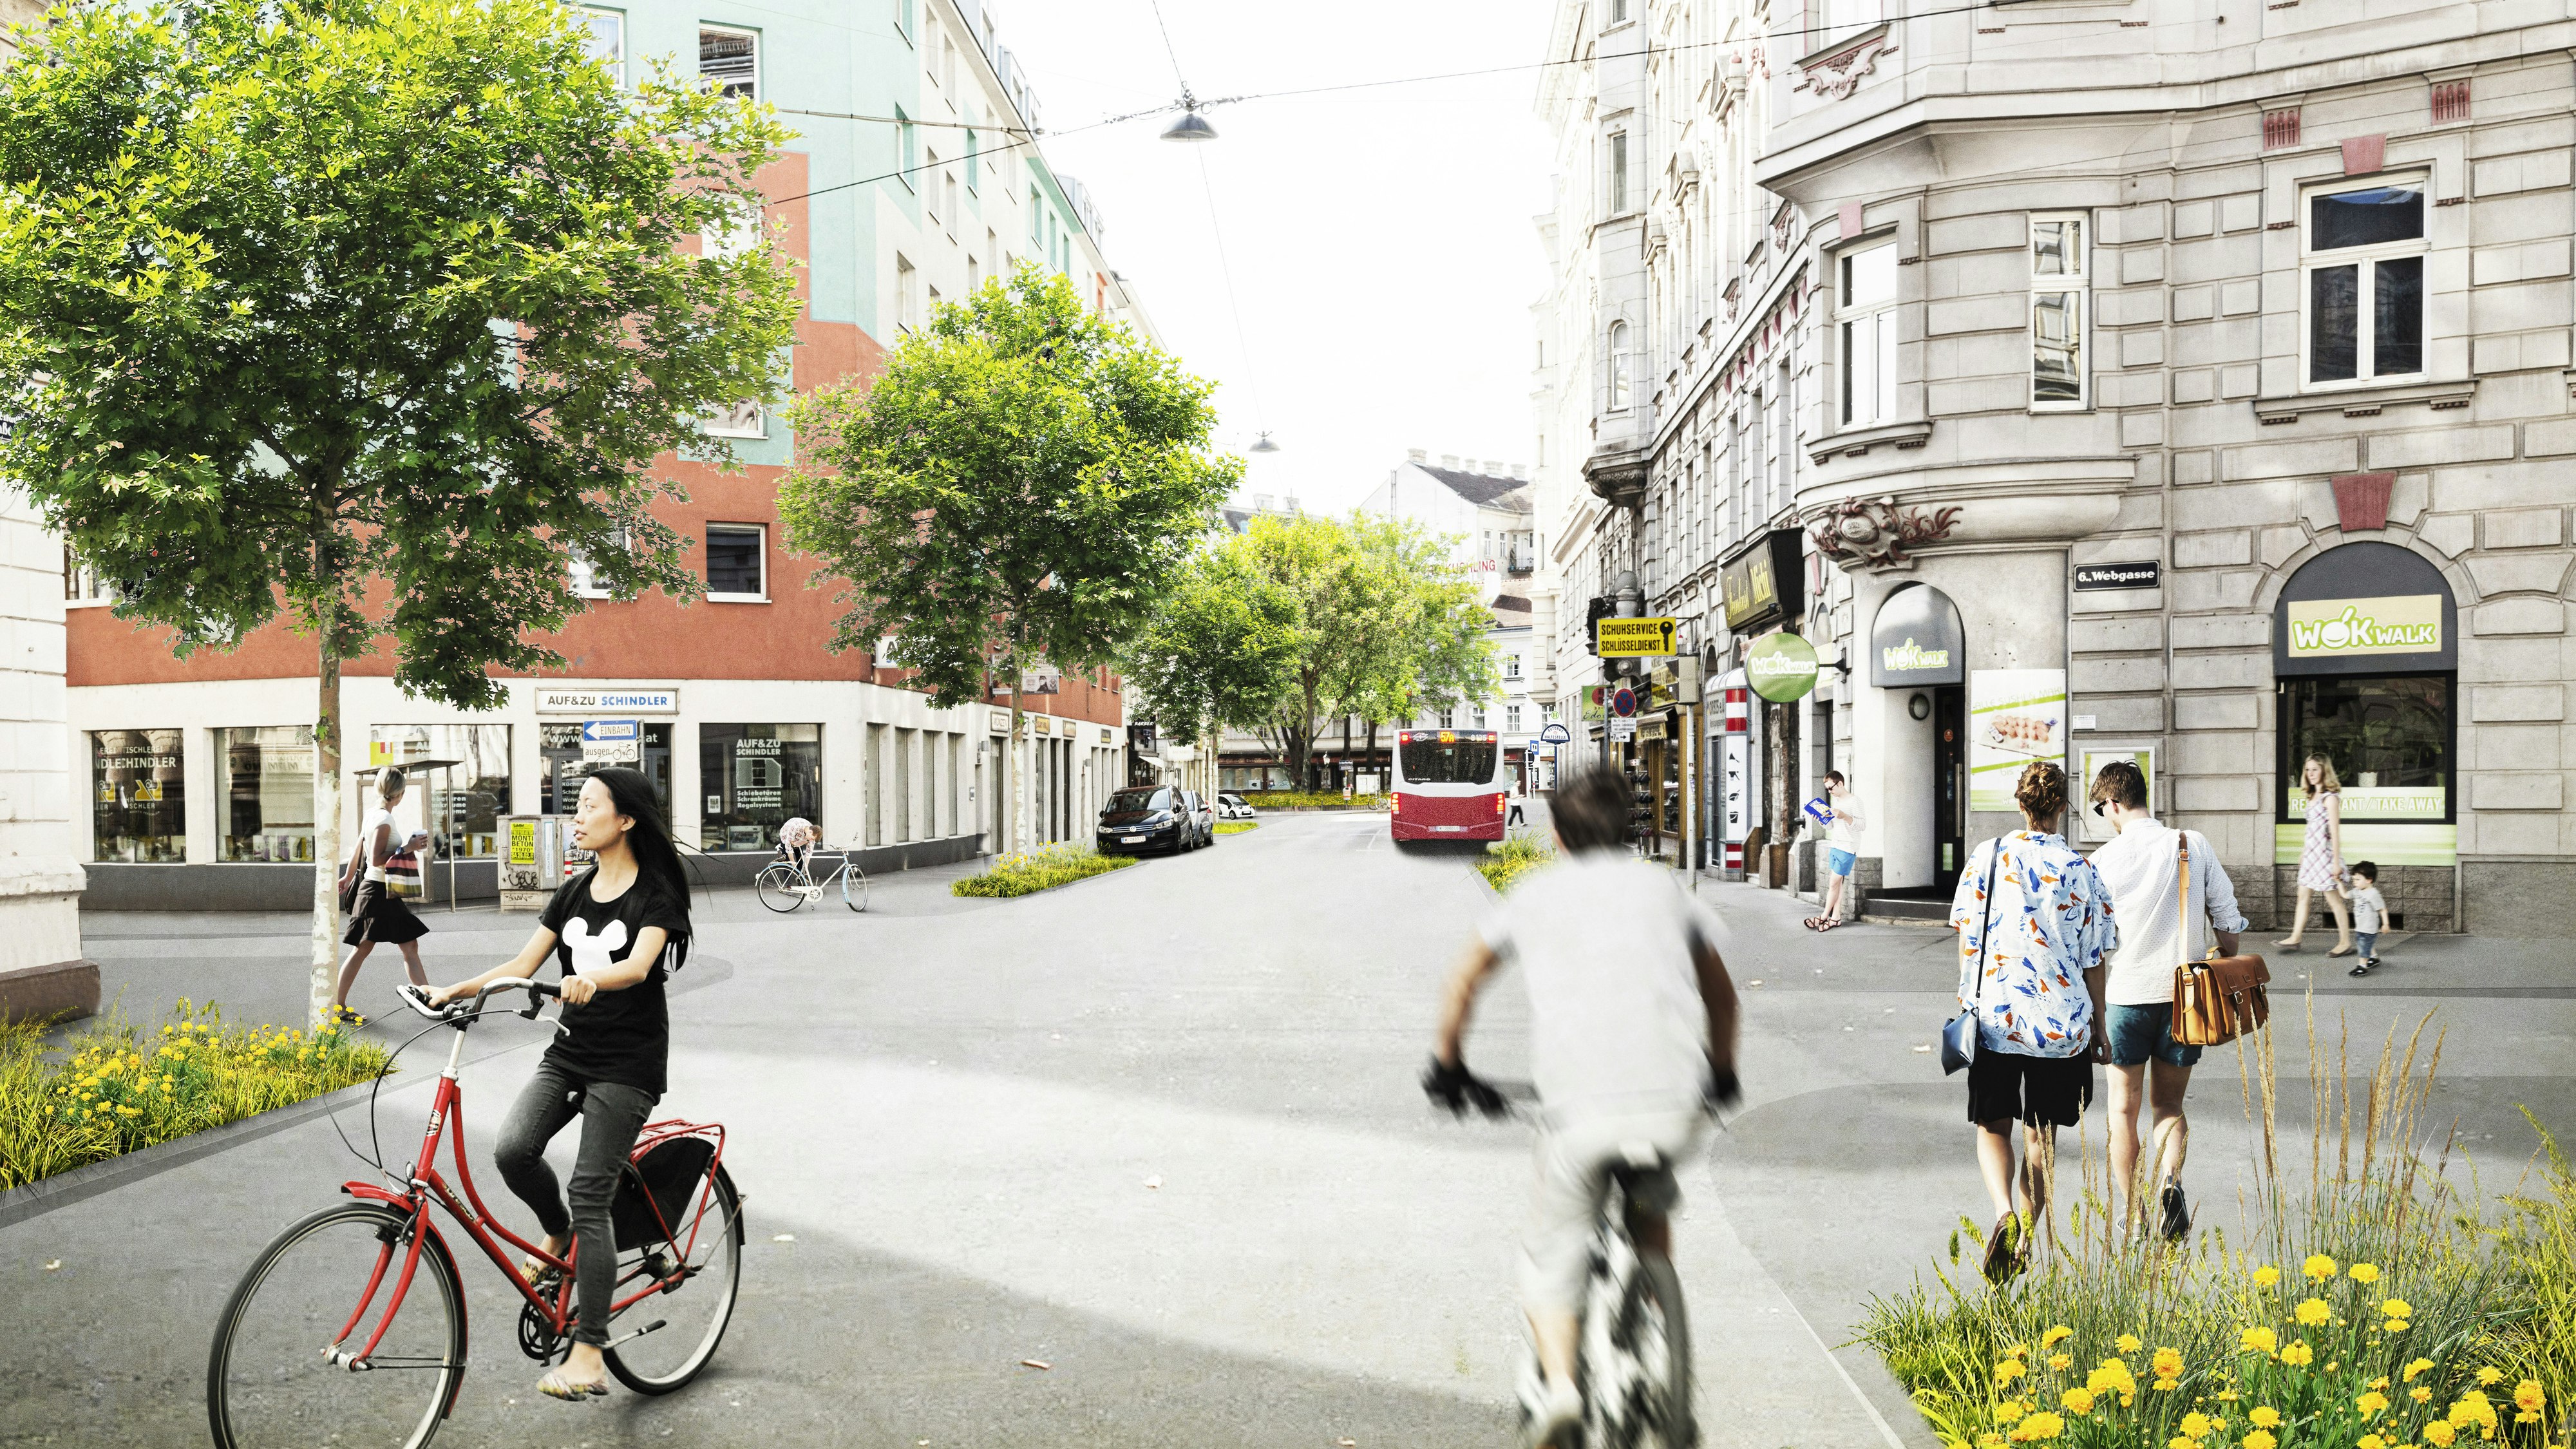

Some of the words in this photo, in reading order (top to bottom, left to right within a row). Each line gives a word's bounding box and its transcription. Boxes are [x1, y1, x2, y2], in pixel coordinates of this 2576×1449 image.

[2091, 571, 2155, 582] Webgasse
[1601, 623, 1658, 636] SCHUHSERVICE
[2375, 626, 2433, 644] WALK
[1601, 638, 1661, 652] SCHLÜSSELDIENST
[1920, 652, 1946, 666] WALK
[1790, 663, 1814, 672] WALK
[547, 696, 596, 706] AUF&ZU
[601, 696, 668, 706] SCHINDLER
[600, 726, 631, 735] EINBAHN
[1440, 732, 1455, 743] 57A
[736, 739, 781, 748] AUF&ZU
[2375, 798, 2405, 811] TAKE
[2407, 797, 2442, 811] AWAY
